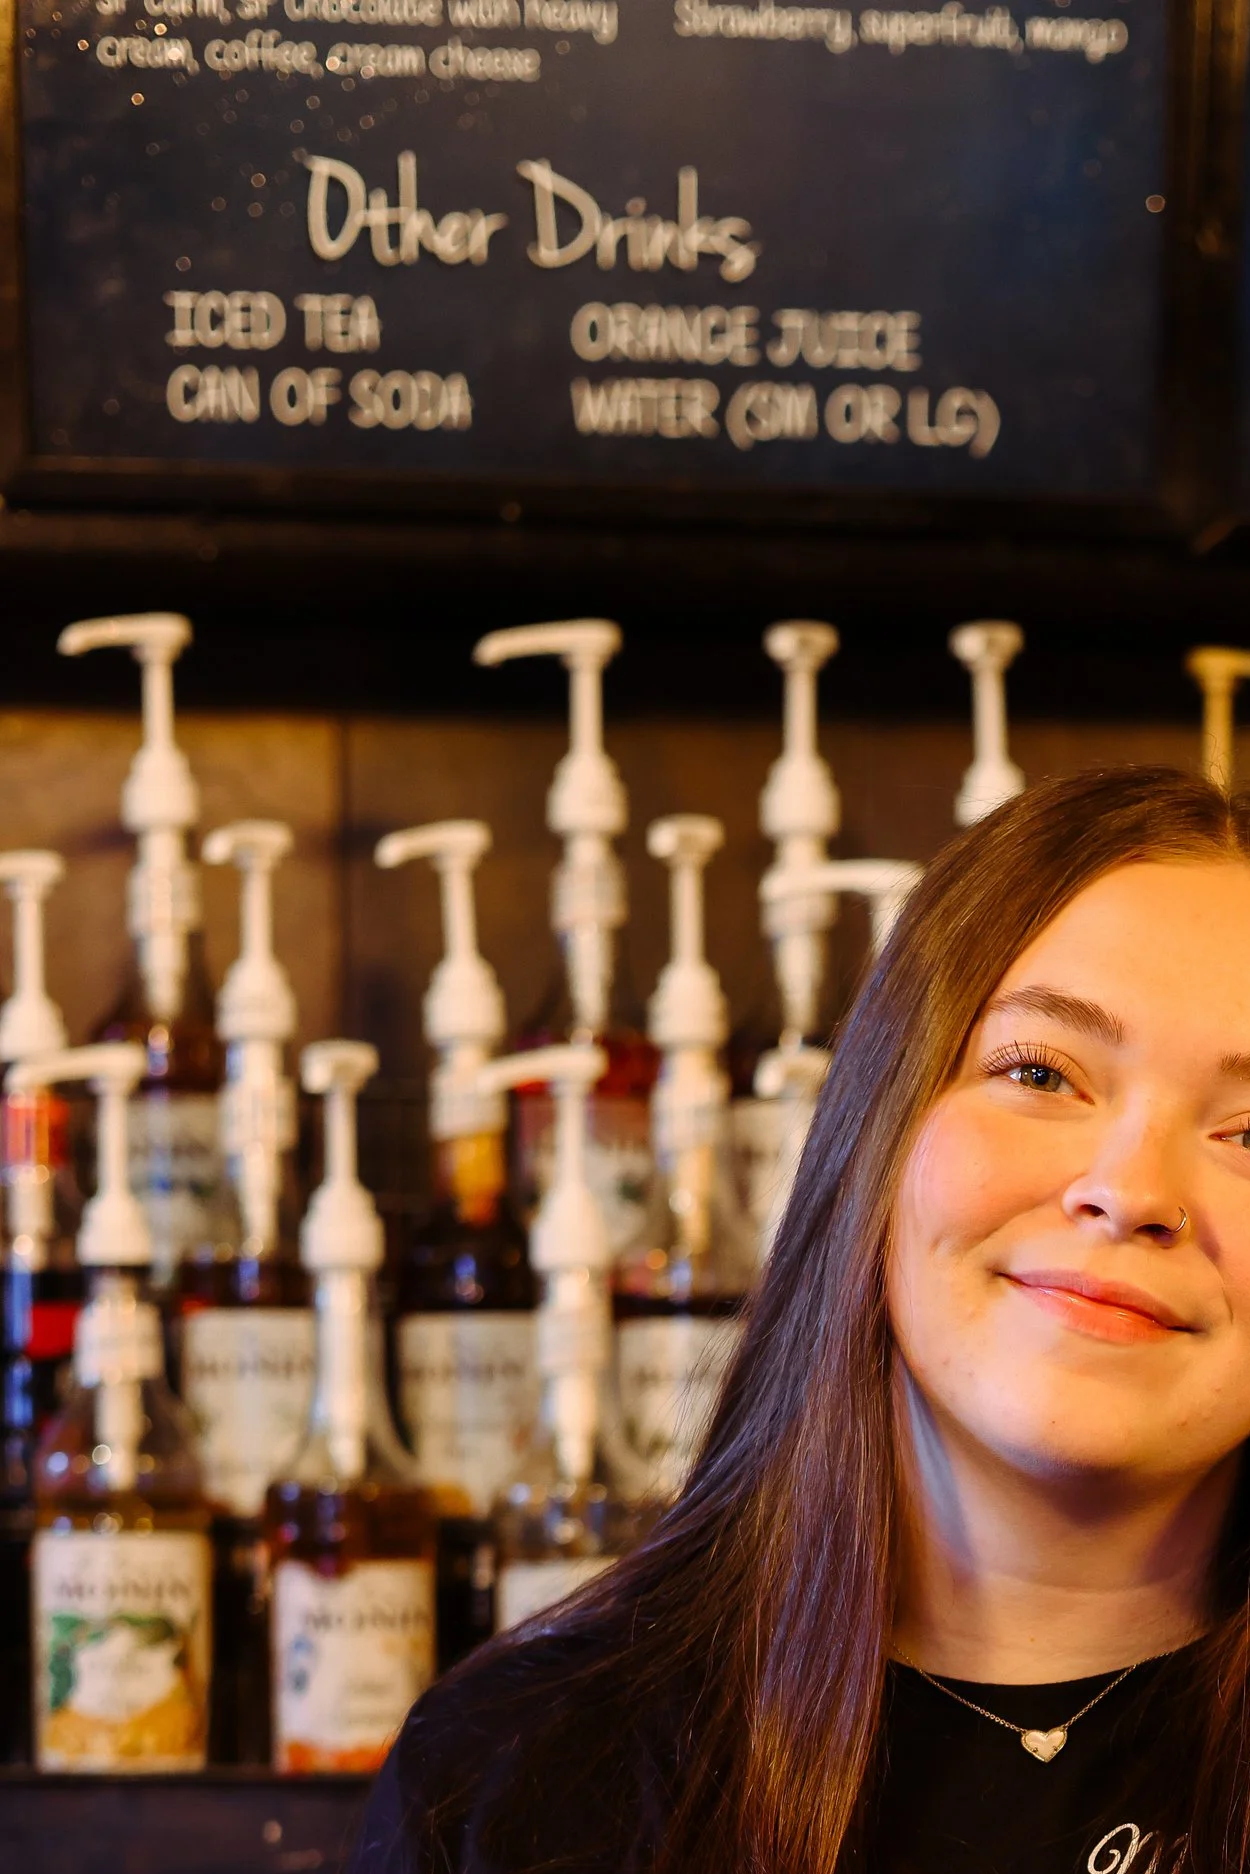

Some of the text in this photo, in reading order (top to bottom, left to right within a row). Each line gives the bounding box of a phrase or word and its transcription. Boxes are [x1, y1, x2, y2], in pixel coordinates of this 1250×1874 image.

[326, 43, 425, 77] cream
[428, 35, 541, 83] cheese
[303, 149, 762, 283] Other Drinks
[163, 290, 382, 352] ICED TEA
[570, 302, 922, 372] ORANGE JUICE
[166, 364, 474, 431] CAN OF SODA
[570, 376, 720, 439] WATER
[825, 383, 900, 444] OR
